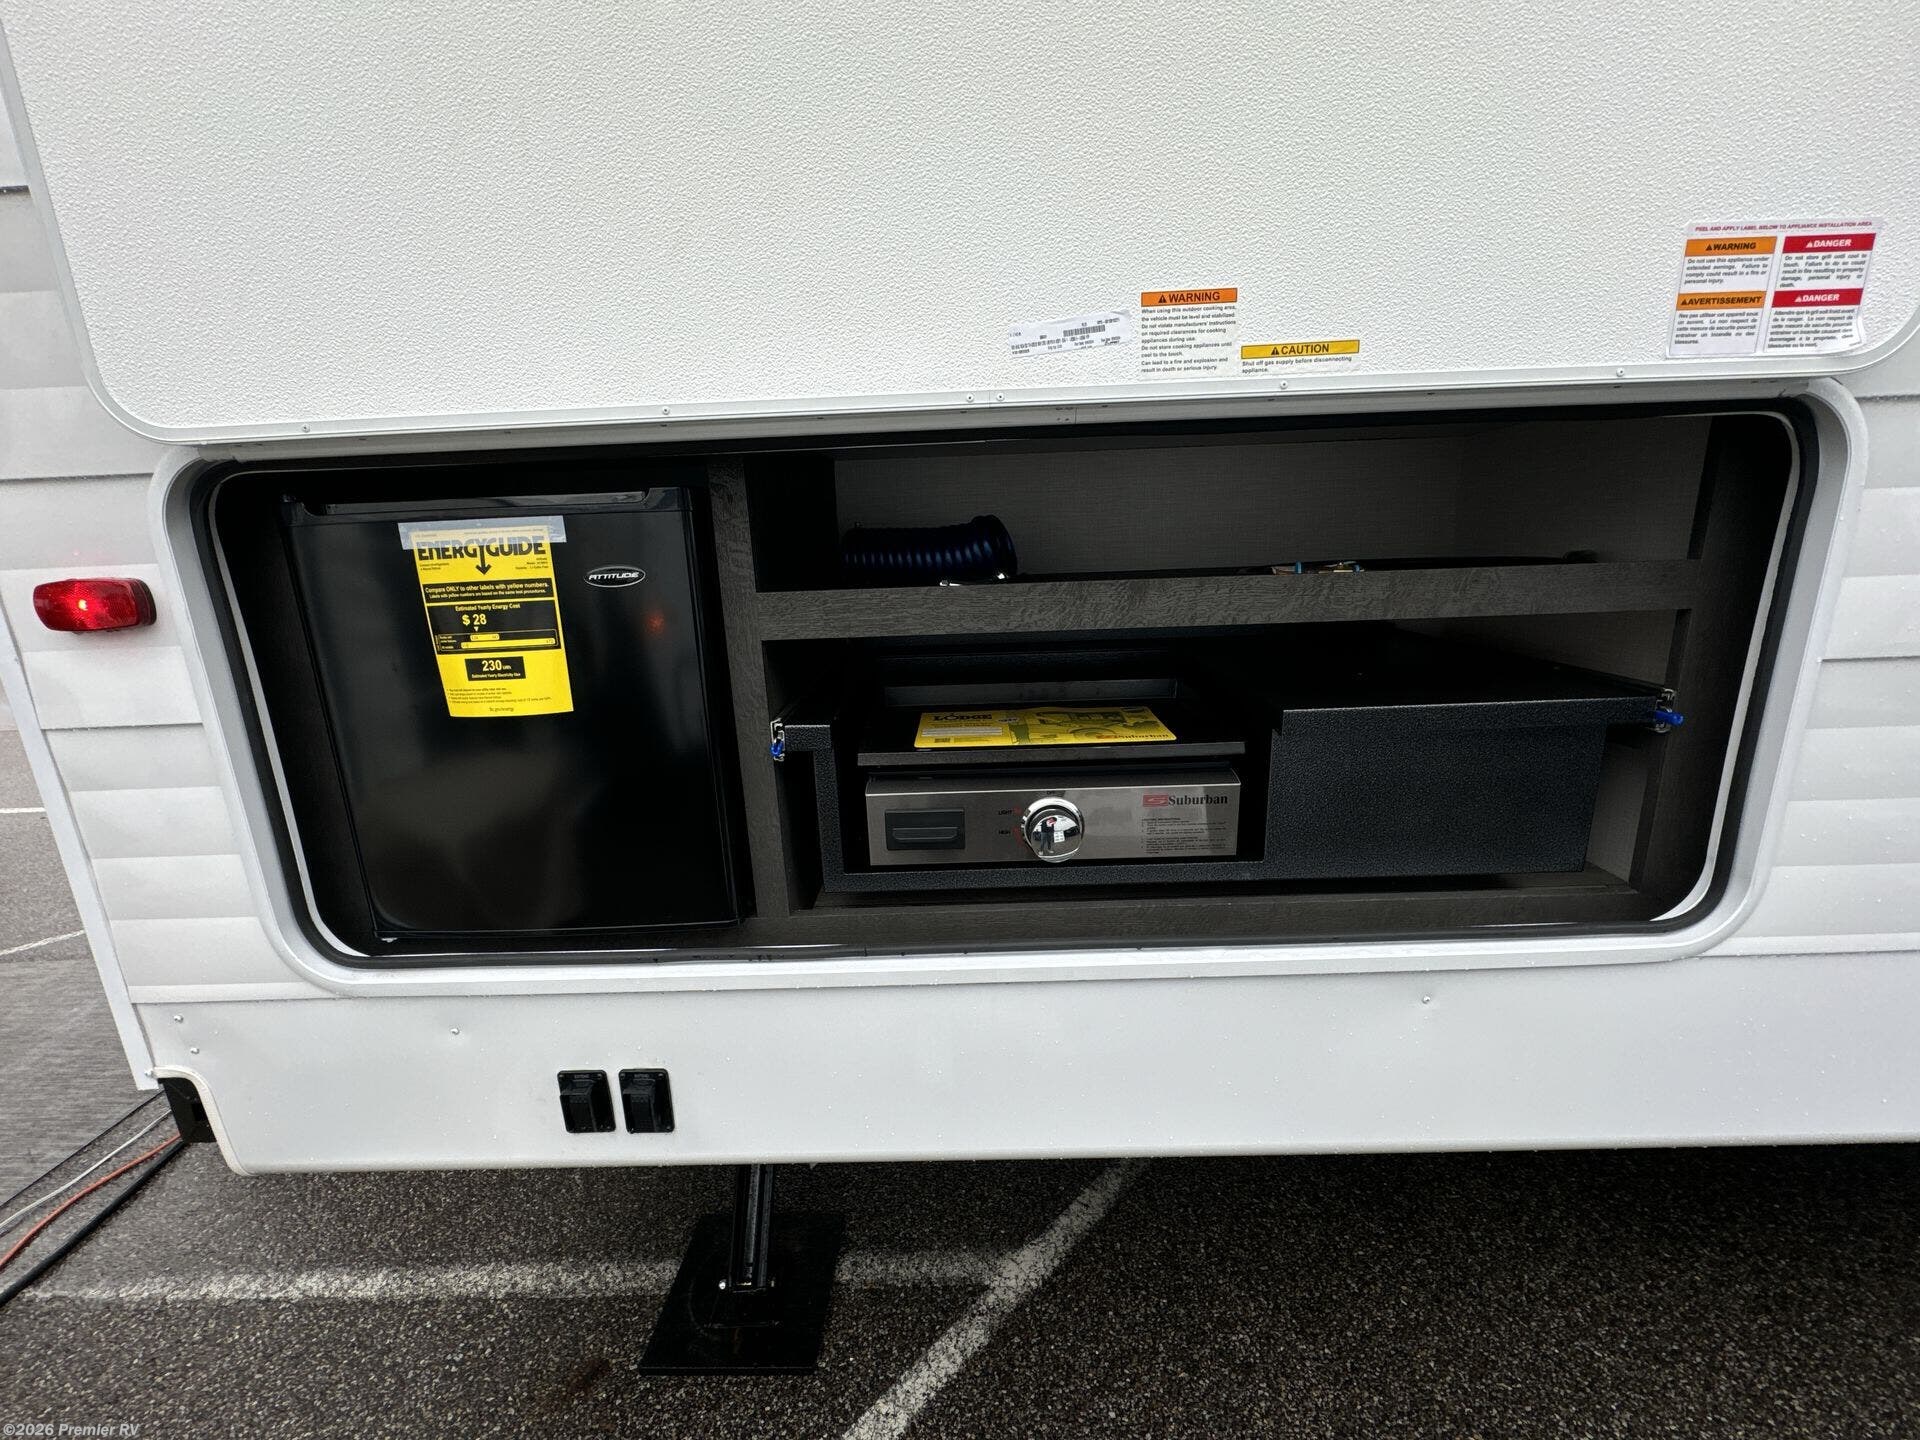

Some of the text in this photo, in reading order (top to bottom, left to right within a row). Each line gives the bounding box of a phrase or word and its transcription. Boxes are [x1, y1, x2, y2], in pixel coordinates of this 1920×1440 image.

[1168, 292, 1220, 302] WARNING
[1688, 296, 1761, 305] AVERTISSEMENT
[1282, 344, 1329, 354] CAUTION
[462, 614, 486, 626] $ 28
[482, 660, 502, 671] 230
[1168, 795, 1227, 805] Suburban
